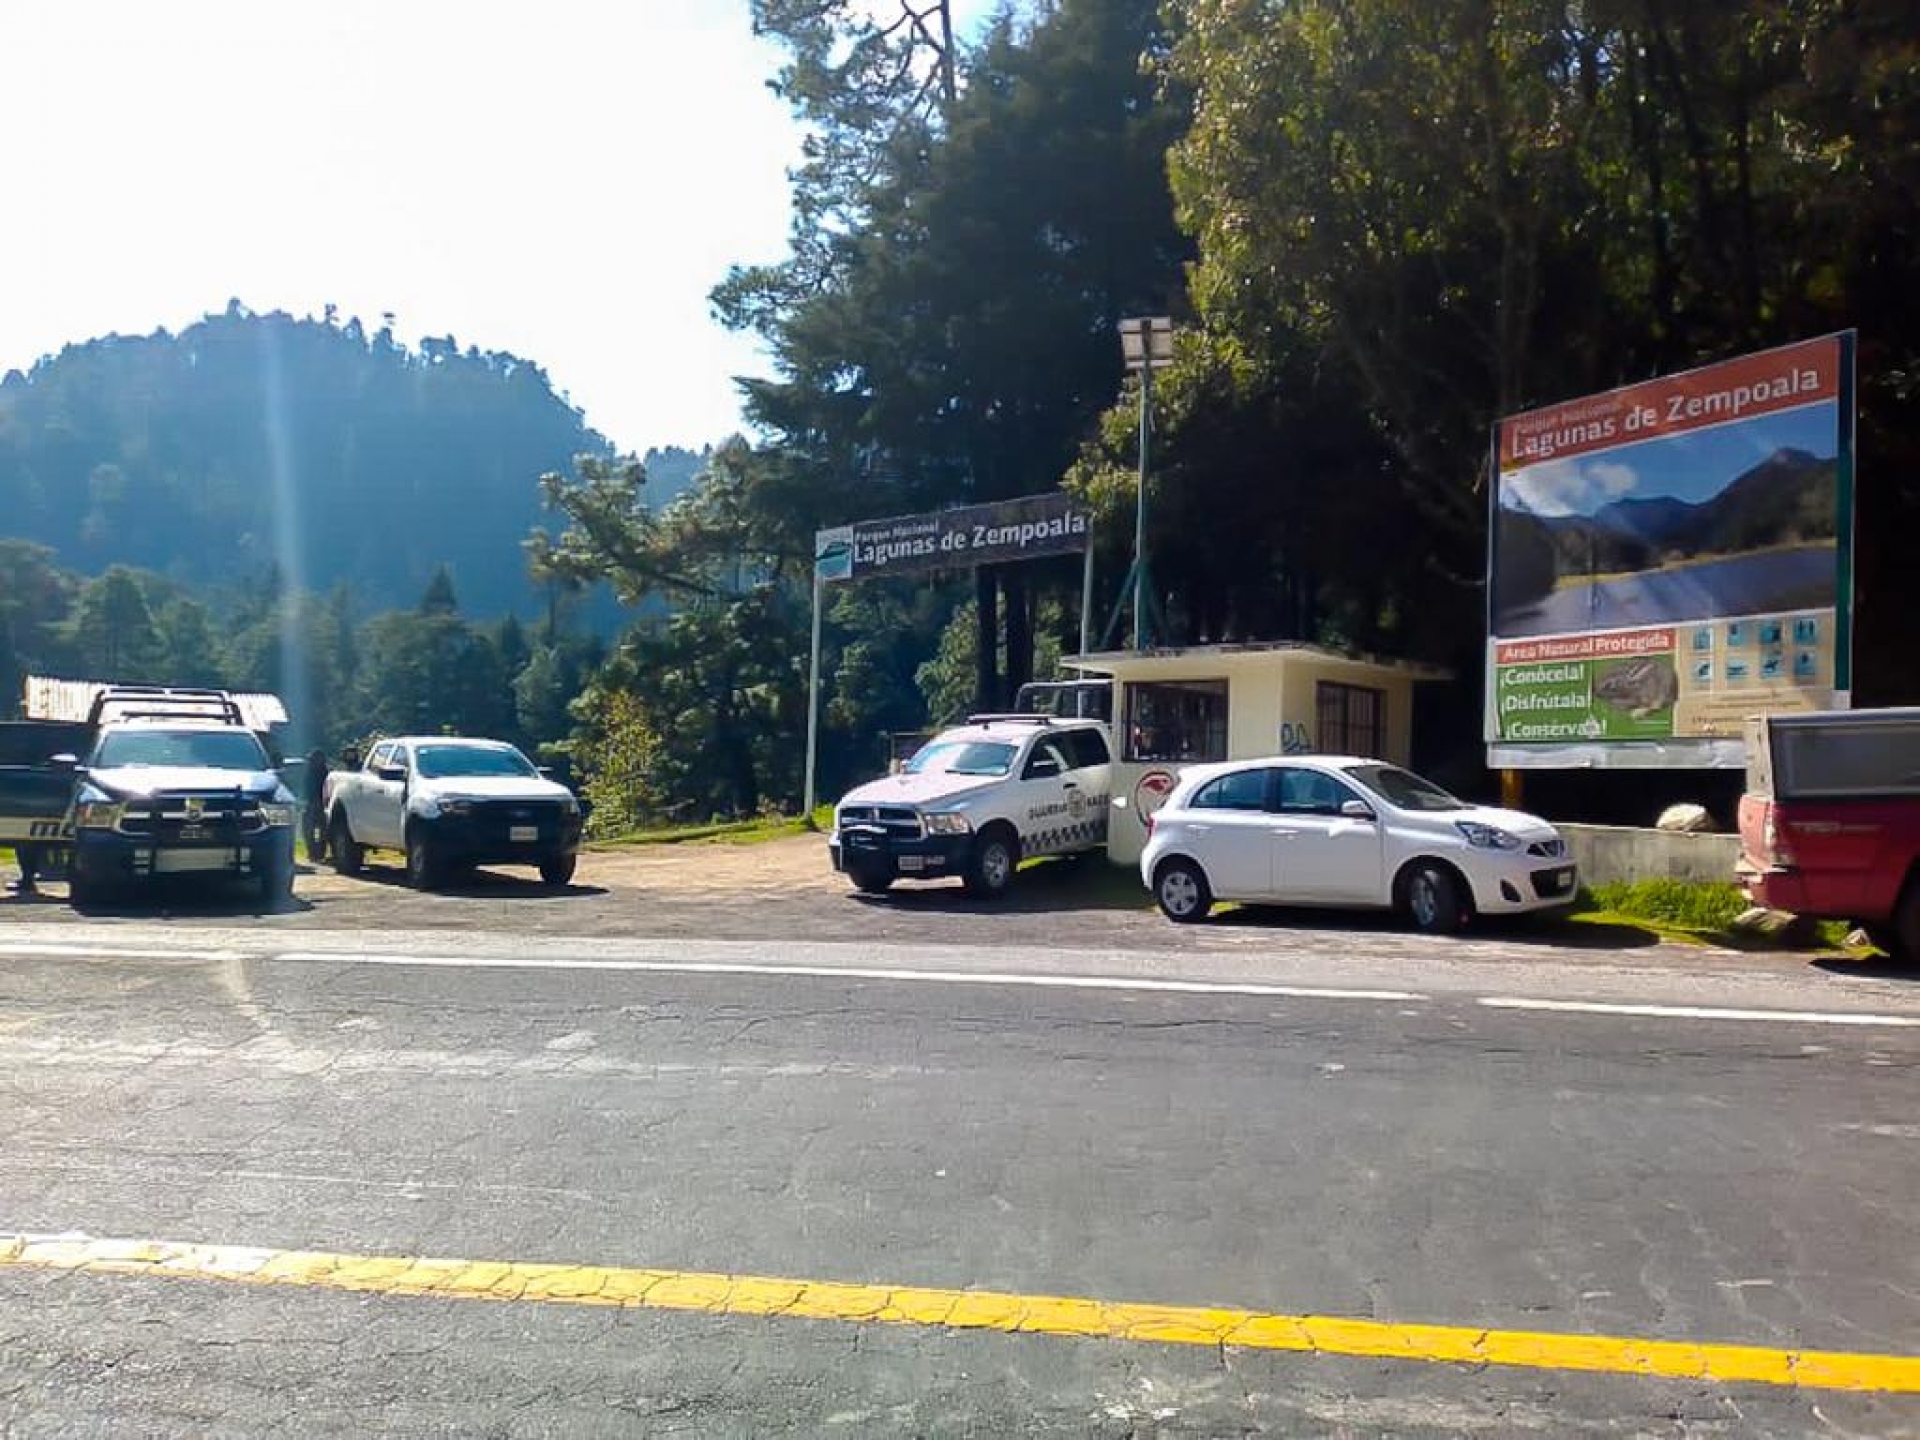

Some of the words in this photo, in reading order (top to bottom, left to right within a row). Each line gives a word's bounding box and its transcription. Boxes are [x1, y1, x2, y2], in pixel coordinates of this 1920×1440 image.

[1512, 418, 1616, 458] Lagunas
[1624, 405, 1657, 431] de
[1665, 368, 1819, 415] Zempoala
[854, 537, 936, 565] Lagunas
[940, 530, 966, 550] de
[972, 509, 1086, 547] Zempoala
[1538, 639, 1592, 656] Natural
[1595, 633, 1669, 653] Protegida
